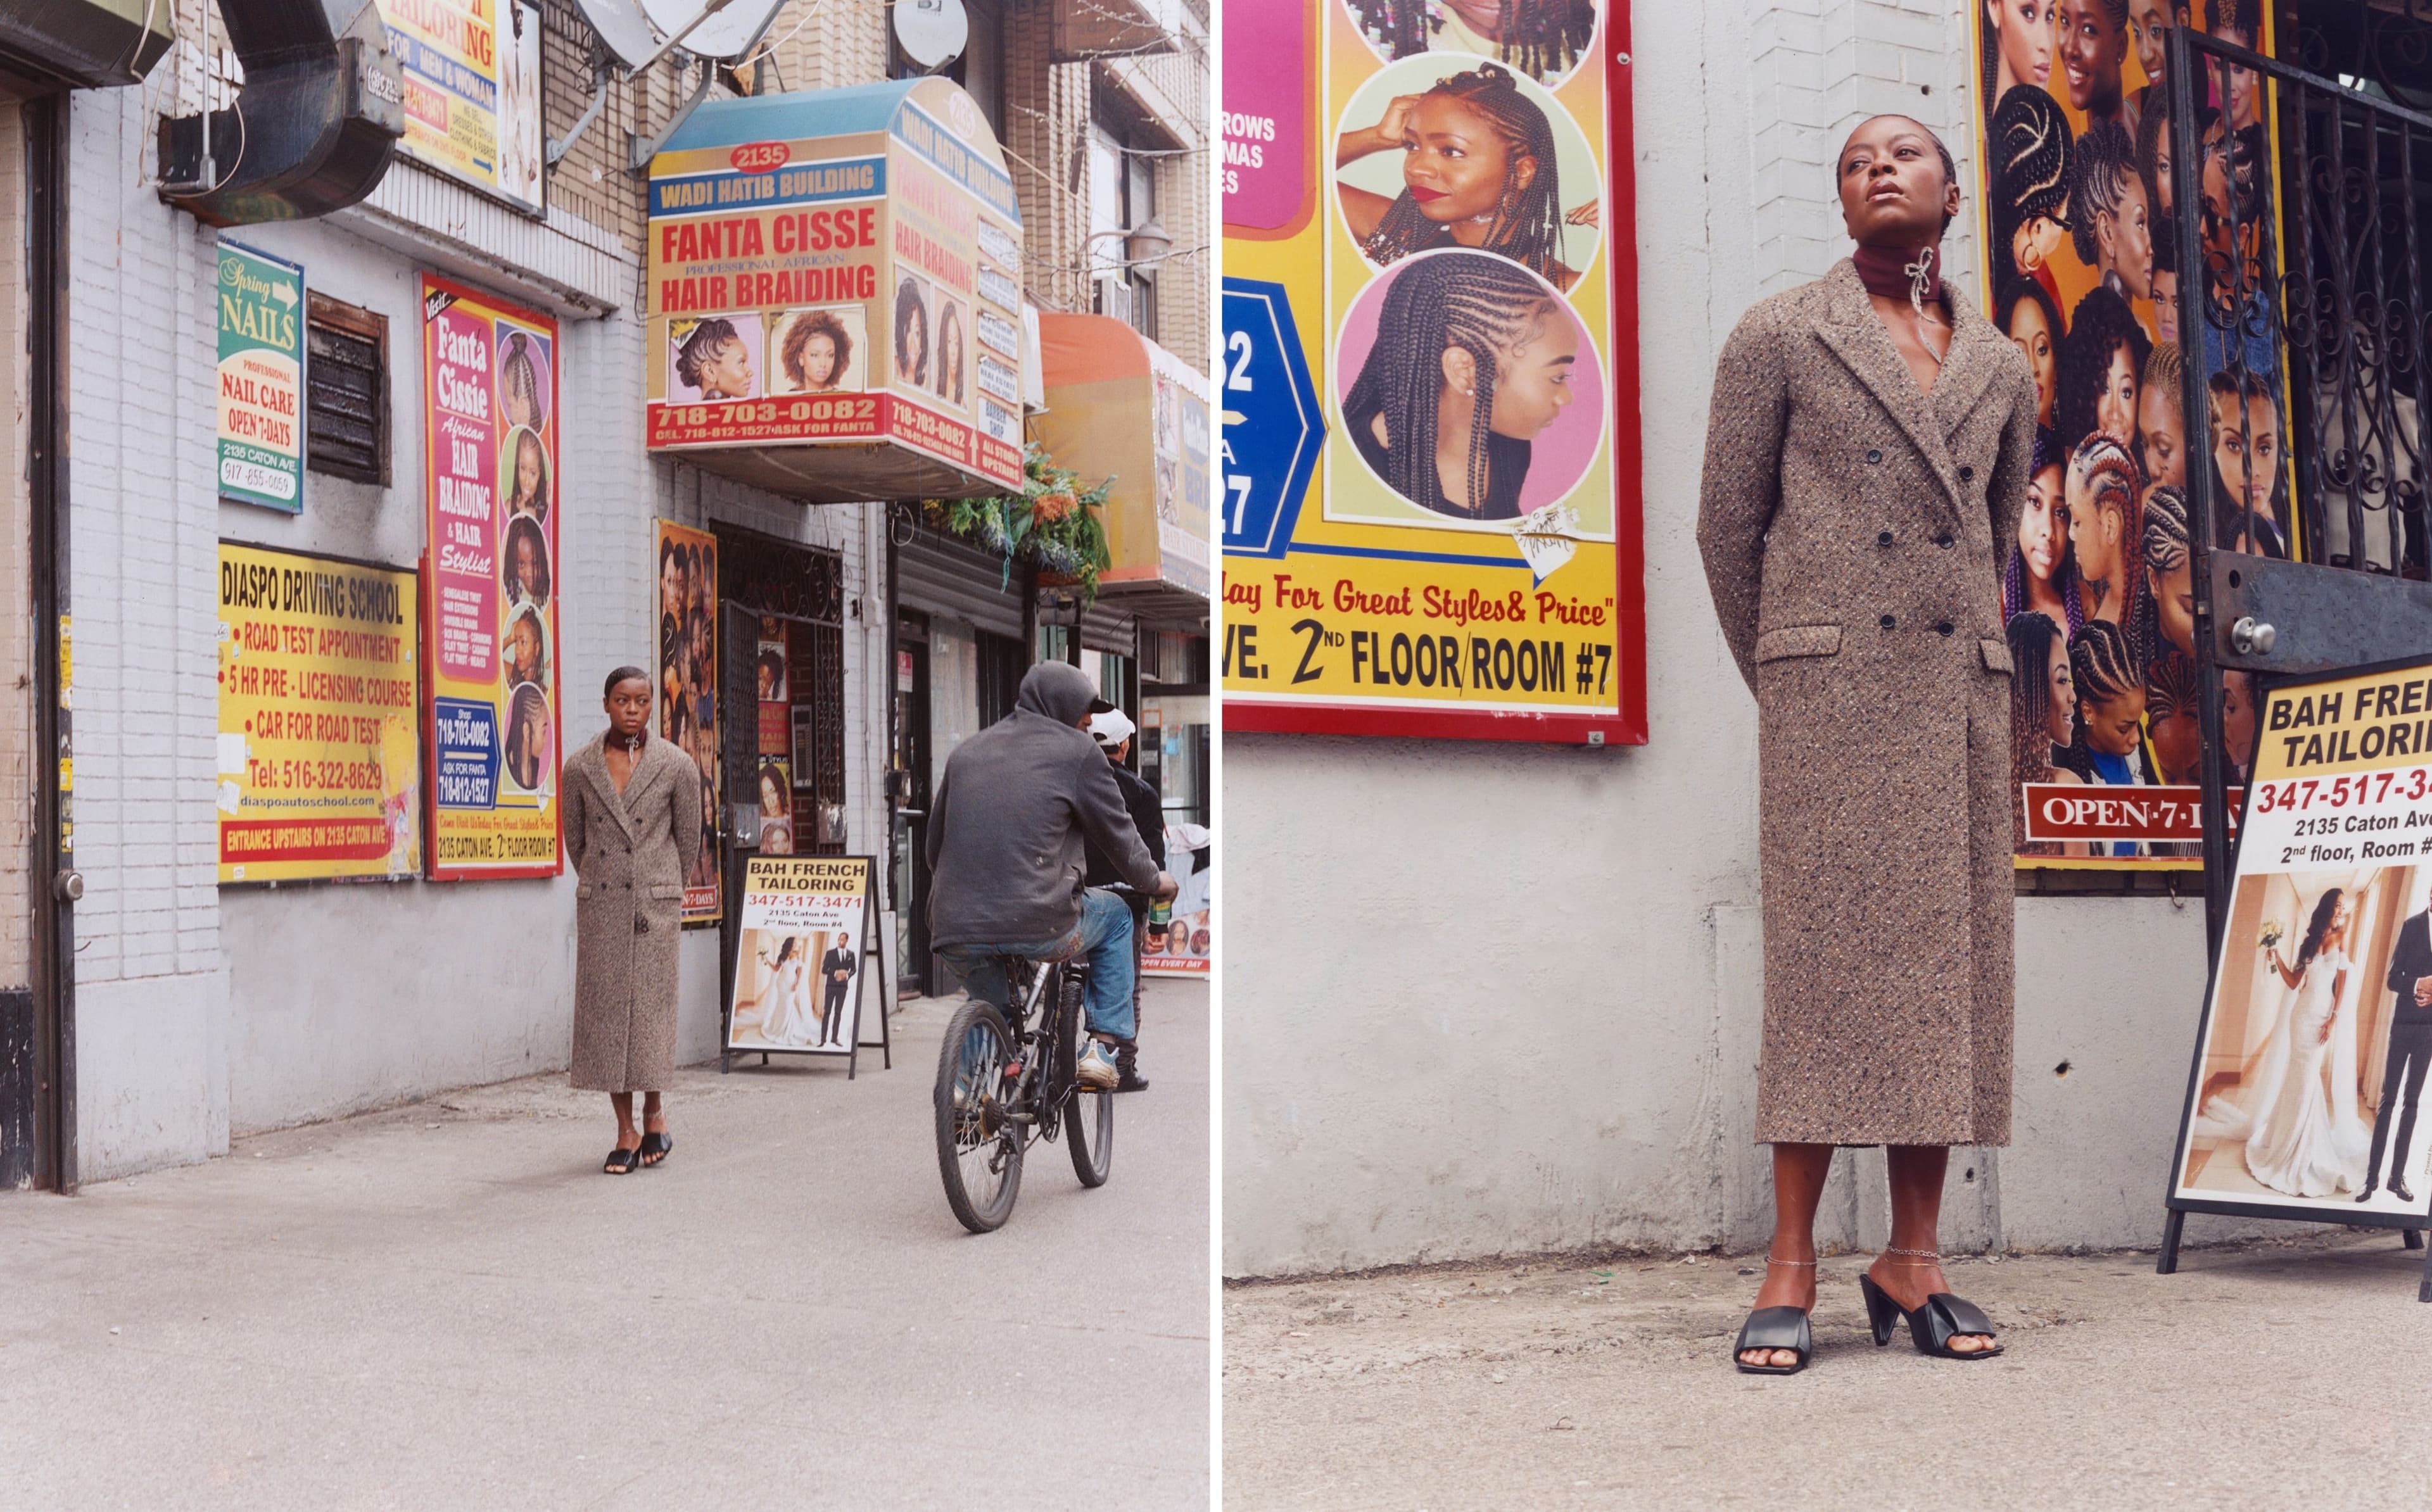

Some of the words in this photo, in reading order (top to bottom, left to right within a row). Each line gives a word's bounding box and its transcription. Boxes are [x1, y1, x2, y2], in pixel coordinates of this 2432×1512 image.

[387, 30, 410, 63] FOR
[420, 47, 443, 81] MEN
[445, 61, 453, 87] &
[455, 67, 493, 106] WOMAN
[736, 144, 786, 167] 2135
[902, 105, 933, 160] WADI
[935, 131, 966, 179] HATIB
[967, 156, 1013, 214] BUILDING
[660, 181, 713, 209] WADI
[718, 175, 775, 203] HATIB
[780, 165, 875, 198] BUILDING
[662, 217, 764, 263] FANTA
[773, 207, 876, 254] CISSE
[685, 260, 776, 277] PROFESSIONAL
[783, 254, 846, 268] AFRICAN
[895, 219, 921, 265] HAIR
[924, 237, 972, 294] BRAIDING
[219, 256, 270, 305] Spring
[661, 276, 728, 313] HAIR
[735, 264, 876, 307] BRAIDING
[221, 293, 296, 352] NAILS
[436, 315, 486, 374] Fanta
[243, 359, 291, 384] PROFESSIONAL
[1222, 330, 1252, 392] 2
[222, 372, 258, 406] NAIL
[260, 384, 295, 417] CARE
[437, 363, 488, 419] Cissie
[228, 408, 256, 437] OPEN
[441, 416, 486, 441] African
[656, 399, 877, 427] 718-703-0082
[892, 401, 966, 449] 718-703-0082
[656, 428, 682, 441] CEL.
[803, 422, 830, 434] FOR
[832, 421, 876, 433] FANTA
[989, 420, 1004, 439] SHOP
[223, 444, 246, 459] 2135
[247, 448, 277, 468] CATON
[451, 439, 479, 481] HAIR
[982, 439, 994, 455] ALL
[225, 462, 243, 481] 917
[982, 454, 1020, 482] UPSTAIRS
[439, 476, 491, 522] BRAIDING
[1222, 474, 1251, 535] 7
[447, 522, 453, 538] &
[455, 521, 482, 548] HAIR
[439, 545, 491, 576] Stylist
[222, 561, 279, 611] DIASPO
[284, 569, 345, 619] DRIVING
[349, 577, 403, 625] SCHOOL
[1274, 574, 1324, 610] For
[1333, 578, 1414, 617] Great
[244, 622, 279, 653] ROAD
[282, 625, 315, 656] TEST
[318, 628, 401, 664] APPOINTMENT
[1576, 642, 1612, 695] #7
[229, 665, 237, 695] 5
[241, 665, 259, 696] HR
[262, 668, 288, 698] PRE
[299, 671, 364, 705] LICENSING
[366, 676, 412, 709] COURSE
[256, 709, 283, 740] CAR
[286, 712, 314, 741] FOR
[316, 713, 350, 744] ROAD
[2269, 691, 2343, 731] BAH
[437, 719, 490, 748] 718-703-0082
[2283, 719, 2432, 768] TAILORI
[248, 758, 278, 789] Tel:
[283, 759, 381, 791] 516-322-8629
[443, 762, 455, 774] ASK
[455, 763, 469, 775] FOR
[468, 764, 486, 776] FANTA
[240, 795, 375, 809] diaspoautoschool.com
[439, 776, 490, 803] 718-812-1527
[2256, 769, 2432, 814] 347-517-3
[227, 829, 272, 852] ENTRANCE
[272, 826, 313, 849] UPSTAIRS
[314, 826, 326, 847] ON
[327, 825, 346, 846] 2135
[346, 824, 370, 845] CATON
[2294, 817, 2339, 837] 2135
[2344, 814, 2398, 833] Caton
[438, 836, 455, 859] 2135
[455, 836, 479, 859] CATON
[507, 836, 528, 858] FLOOR
[528, 836, 547, 857] ROOM
[2280, 845, 2306, 864] 2nd
[2310, 845, 2355, 863] floor,
[2361, 841, 2414, 859] Room
[750, 862, 787, 875] BAH
[792, 863, 865, 877] FRENCH
[758, 877, 855, 891] TAILORING
[747, 894, 862, 909] 347-517-3471
[778, 919, 801, 928] floor,
[1160, 959, 1186, 968] EVERY
[1186, 961, 1203, 969] DAY
